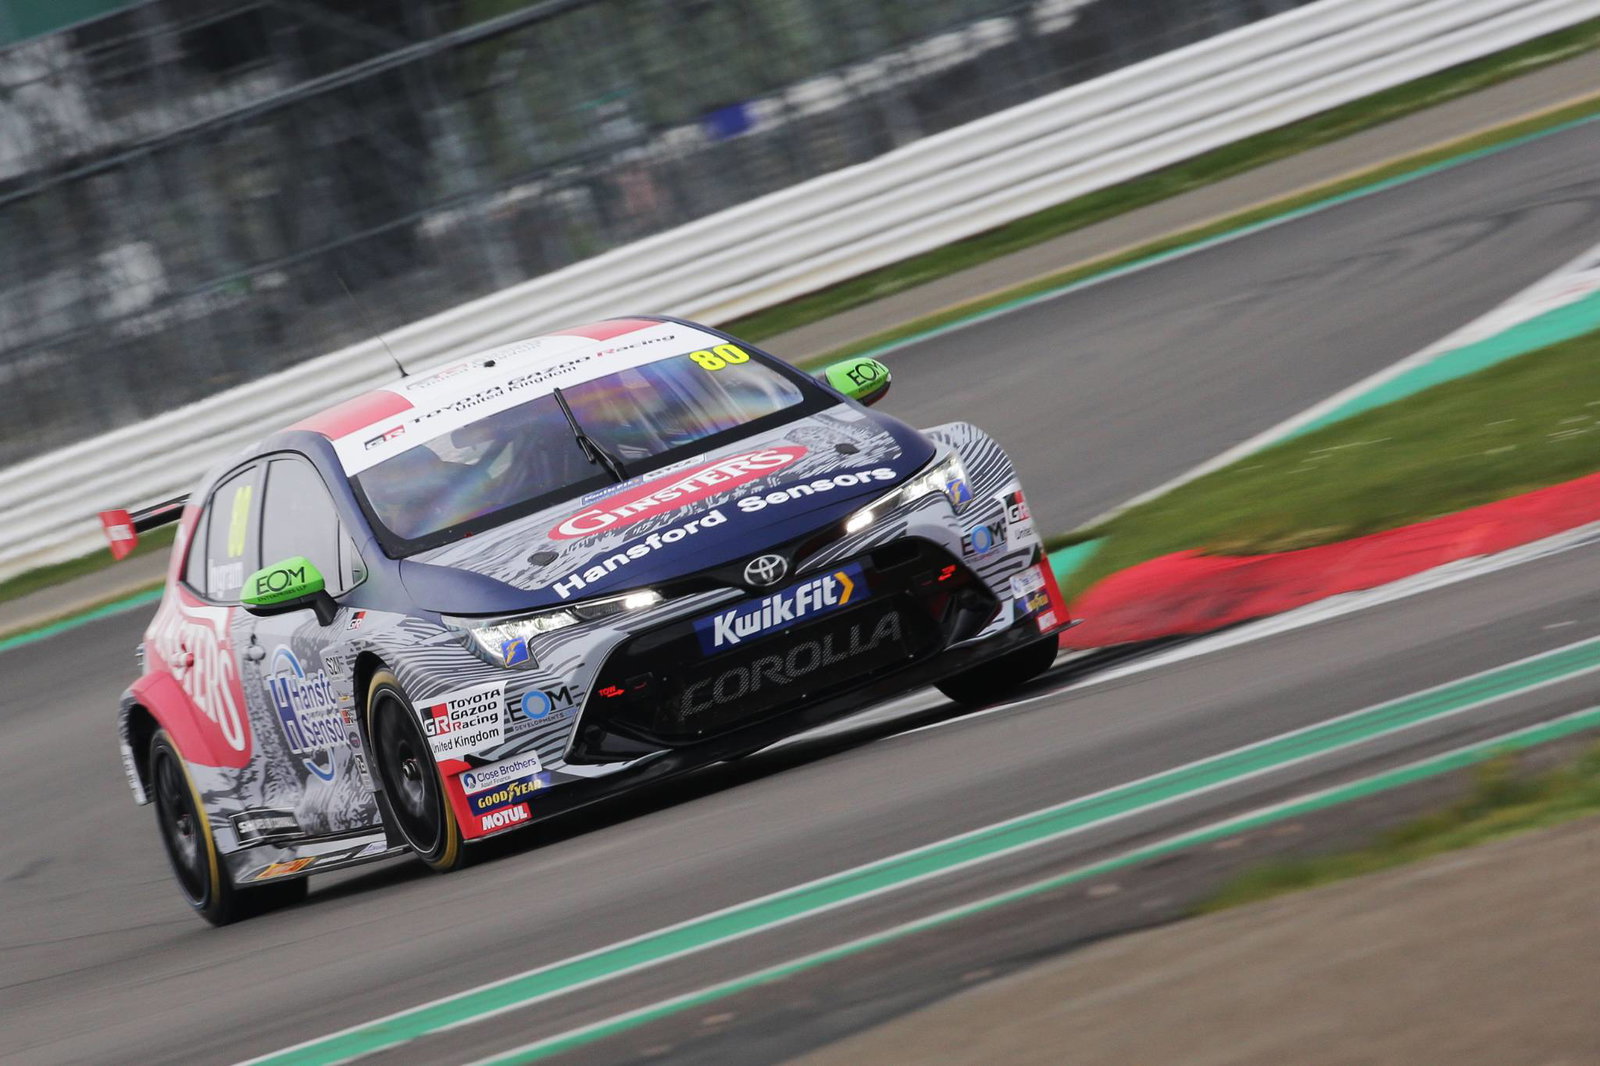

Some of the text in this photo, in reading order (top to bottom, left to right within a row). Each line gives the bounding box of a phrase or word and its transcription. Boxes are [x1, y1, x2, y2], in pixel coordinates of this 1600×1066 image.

[689, 343, 750, 371] 80
[408, 385, 501, 423] TOYOTA
[507, 355, 591, 386] GAZOO
[597, 334, 675, 358] Racing
[846, 361, 886, 386] EOM
[456, 365, 577, 412] United Kingdom
[558, 448, 795, 535] GINSTERS
[552, 467, 897, 600] Hansford Sensors
[256, 566, 306, 596] EOM
[680, 610, 901, 722] COROLLA
[448, 688, 501, 711] TOYOTA
[451, 701, 497, 721] GAZOO
[507, 685, 574, 722] EOM
[423, 715, 451, 737] GR
[452, 711, 499, 732] Racing
[454, 726, 500, 749] Kingdom
[477, 757, 537, 783] Close Brothers
[478, 779, 542, 809] GOODYEAR
[482, 805, 528, 831] MOTUL
